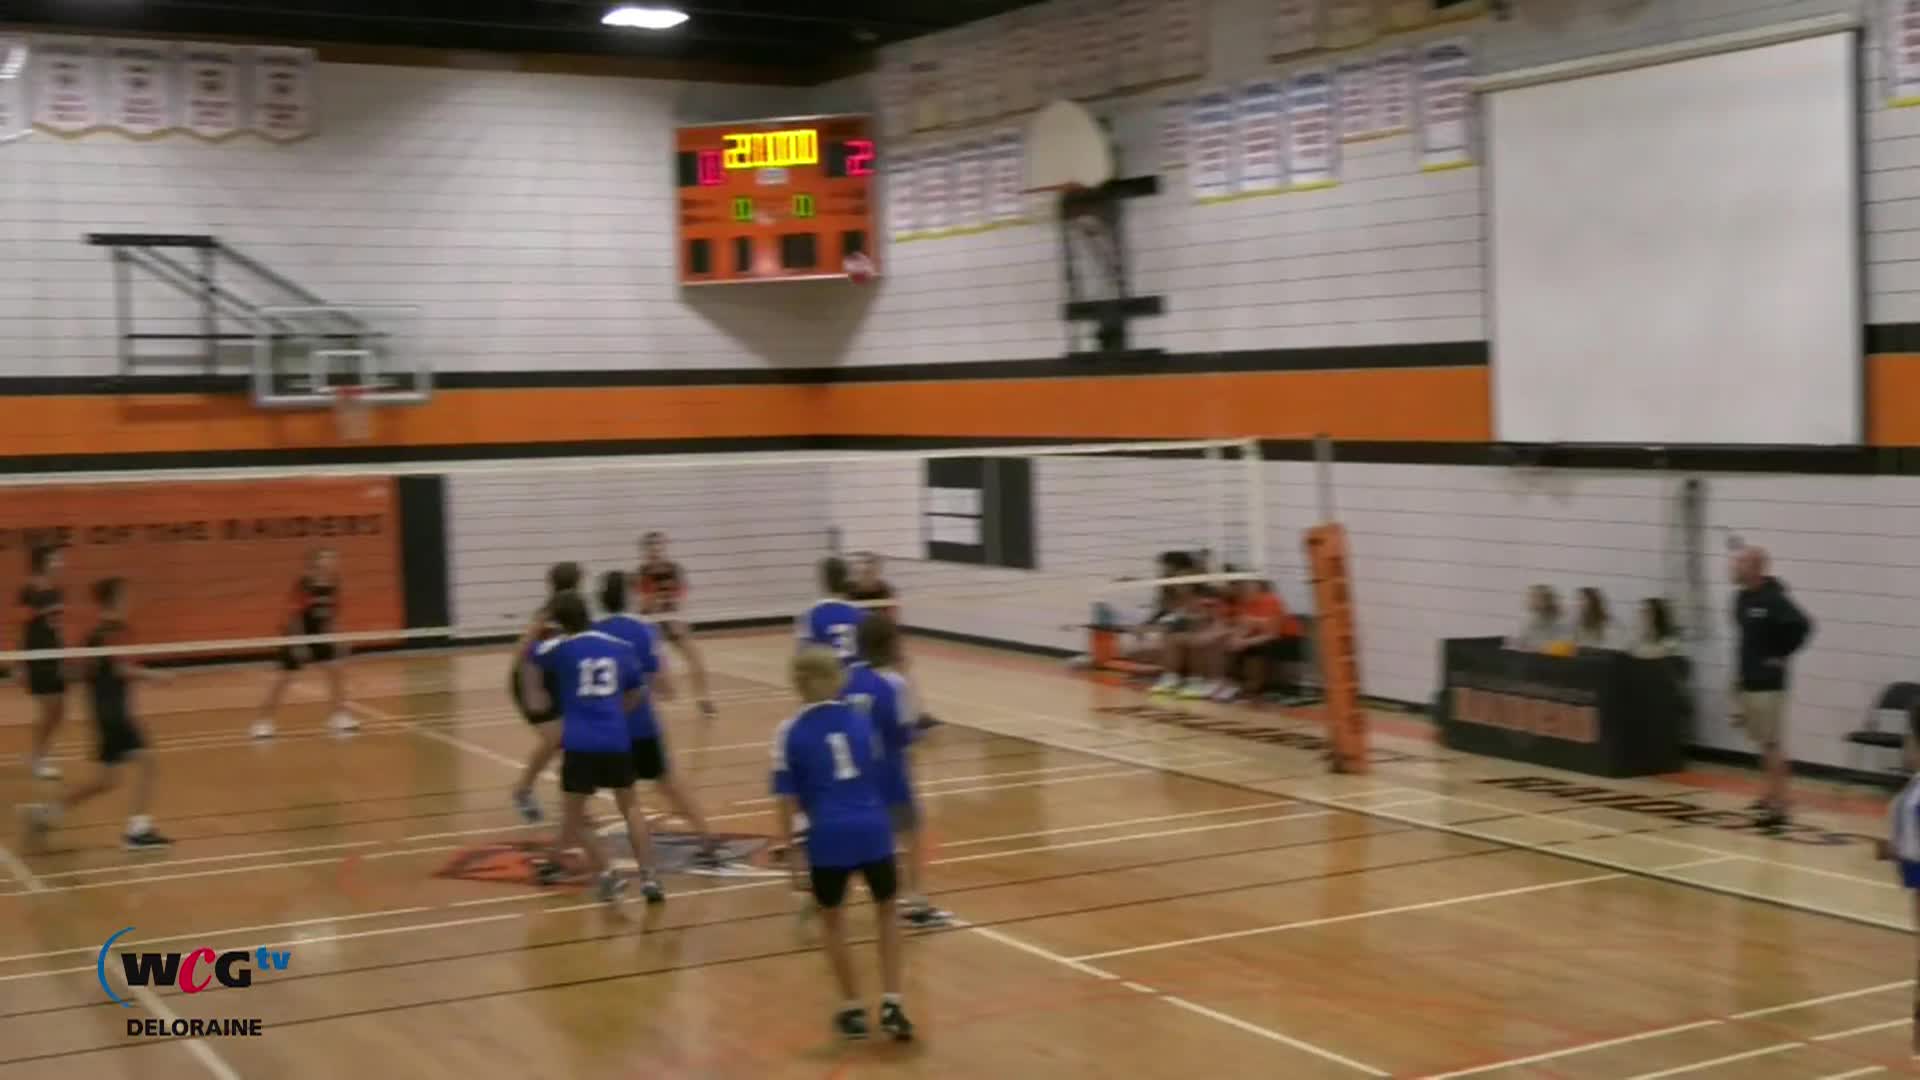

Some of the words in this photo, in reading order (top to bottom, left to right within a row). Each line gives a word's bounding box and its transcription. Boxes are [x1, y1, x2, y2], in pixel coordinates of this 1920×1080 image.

[845, 140, 875, 176] 2
[87, 524, 130, 545] OF
[144, 520, 208, 542] THE
[219, 514, 382, 541] RAIDERS
[577, 657, 618, 696] 13
[826, 732, 860, 780] 1
